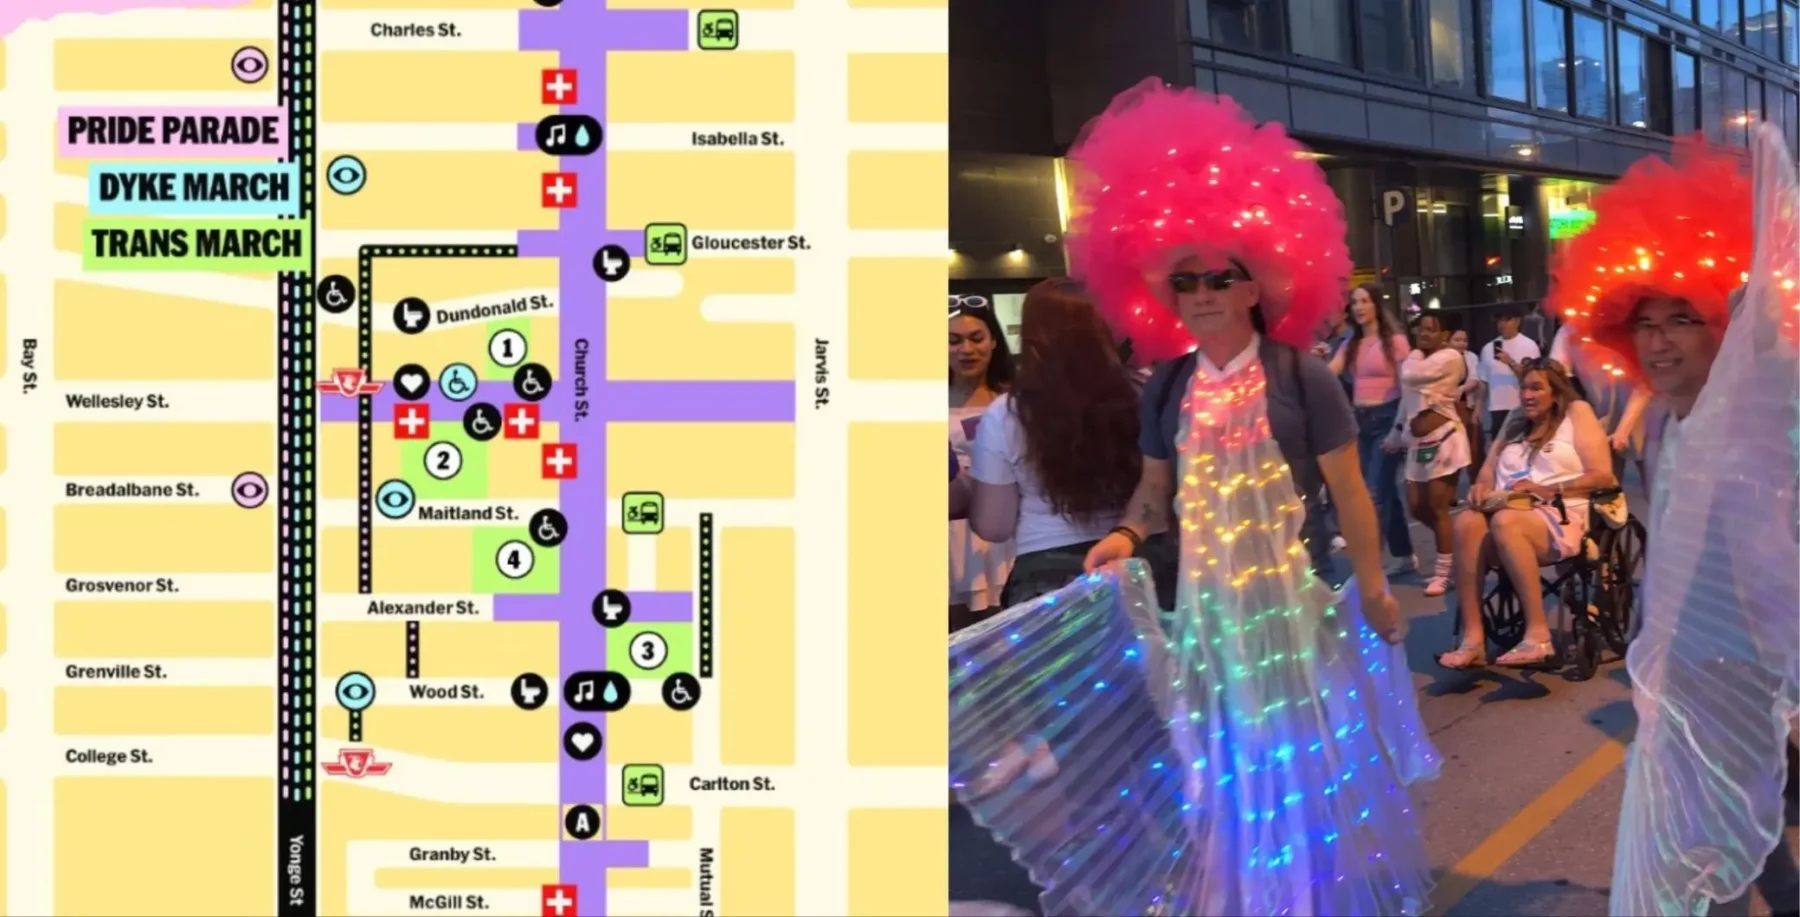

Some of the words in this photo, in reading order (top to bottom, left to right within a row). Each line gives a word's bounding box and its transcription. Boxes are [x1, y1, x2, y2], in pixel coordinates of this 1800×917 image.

[370, 22, 435, 37] Charles
[438, 22, 461, 37] St.
[67, 115, 156, 145] PRIDE
[161, 115, 280, 145] PARADE
[692, 131, 758, 146] Isabella
[761, 131, 784, 146] St.
[99, 172, 177, 202] DYKE
[182, 172, 290, 202] MARCH
[1384, 190, 1406, 225] P
[90, 228, 190, 258] TRANS
[195, 228, 303, 258] MARCH
[691, 235, 785, 250] Gloucester
[787, 235, 811, 250] St.
[435, 297, 529, 325] Dundonald
[528, 293, 556, 312] St.
[20, 338, 38, 369] Bay
[503, 338, 513, 358] 1
[574, 338, 589, 397] Church
[815, 338, 829, 384] Jarvis
[22, 372, 38, 394] St.
[65, 394, 144, 411] Wellesley
[146, 393, 169, 409] St.
[815, 387, 830, 410] St.
[574, 400, 589, 422] St.
[437, 450, 450, 470] 2
[65, 482, 173, 497] Breadalbane
[176, 482, 199, 497] St.
[418, 506, 493, 520] Maitland
[495, 505, 519, 520] St.
[507, 550, 521, 570] 4
[65, 577, 154, 593] Grosvenor
[155, 577, 179, 593] St.
[367, 600, 454, 615] Alexander
[455, 600, 479, 615] St.
[641, 641, 655, 661] 3
[65, 664, 141, 679] Grenville
[143, 664, 167, 679] St.
[409, 684, 458, 699] Wood
[460, 684, 484, 699] St.
[65, 748, 127, 766] College
[130, 748, 153, 763] St.
[689, 776, 750, 791] Carlton
[752, 776, 776, 791] St.
[575, 812, 590, 832] A
[287, 835, 304, 884] Yonge
[409, 846, 470, 864] Granby
[473, 846, 496, 861] St.
[699, 847, 714, 907] Mutual
[290, 888, 304, 906] St
[409, 894, 462, 910] McGill
[466, 895, 489, 910] St.
